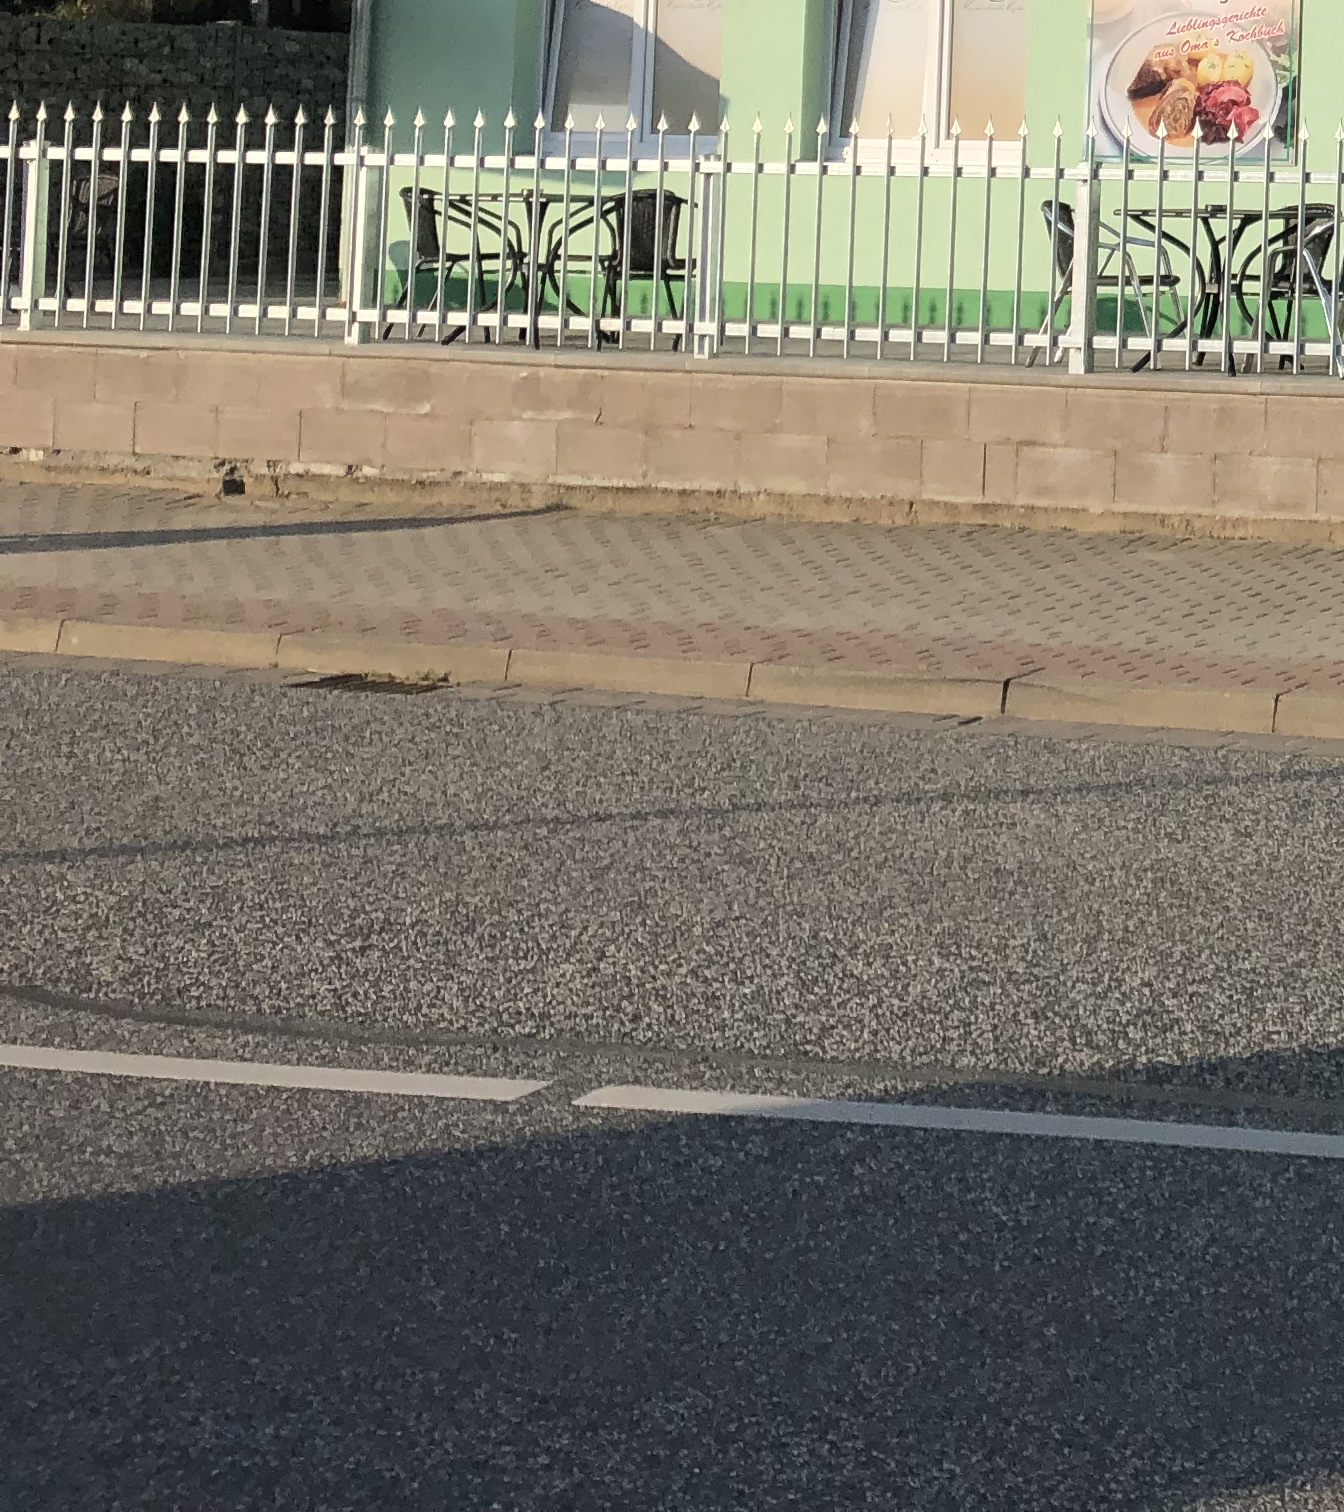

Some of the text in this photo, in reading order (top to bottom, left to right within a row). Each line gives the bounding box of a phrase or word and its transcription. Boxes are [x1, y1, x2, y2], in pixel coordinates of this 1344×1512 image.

[1165, 4, 1267, 36] Lieblingsgerichte
[1153, 48, 1175, 59] aus
[1226, 19, 1285, 44] Kochbuch
